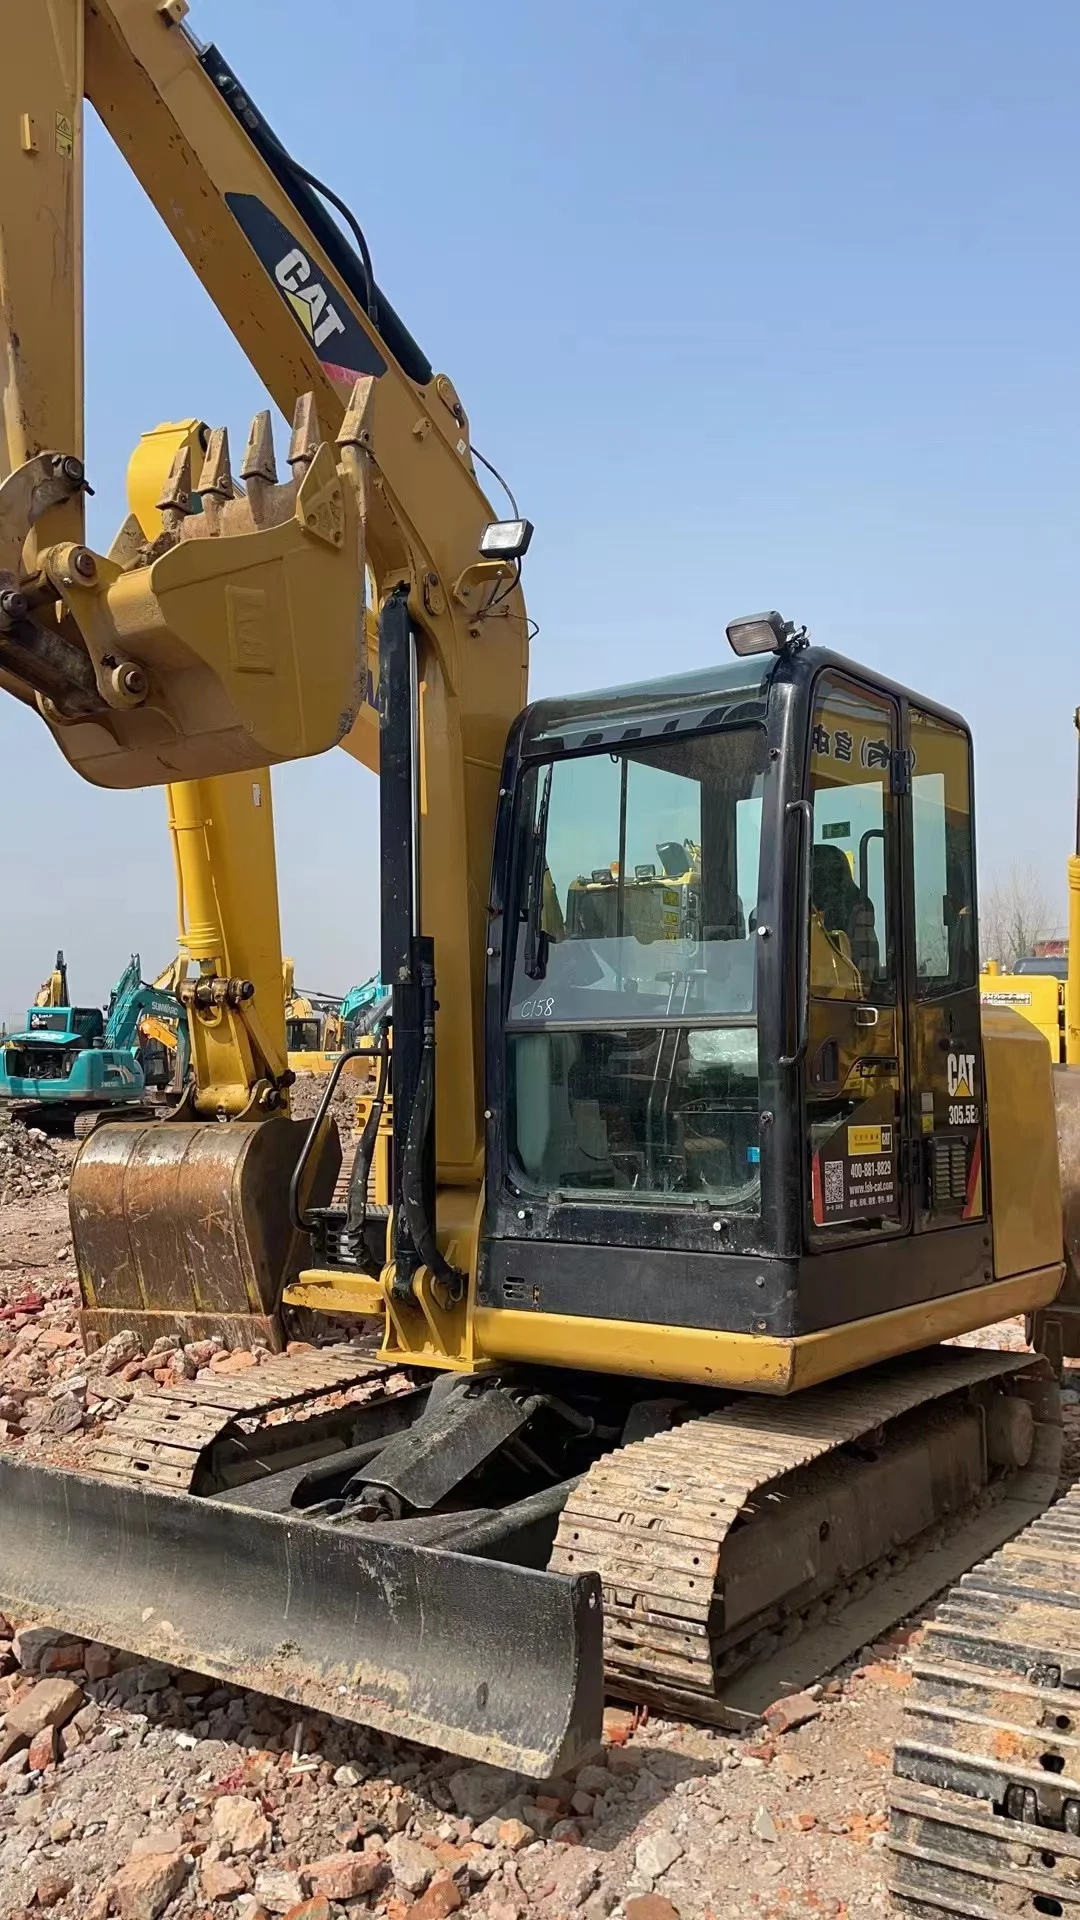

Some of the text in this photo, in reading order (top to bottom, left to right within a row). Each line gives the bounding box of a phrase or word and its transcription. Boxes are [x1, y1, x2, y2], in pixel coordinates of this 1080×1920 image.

[275, 248, 346, 347] CAT
[521, 997, 555, 1017] C158
[947, 1053, 976, 1097] CAT
[881, 1132, 891, 1145] CAT
[850, 1160, 891, 1178] 400-881-8829
[849, 1181, 894, 1195] www.lsh-cat.com
